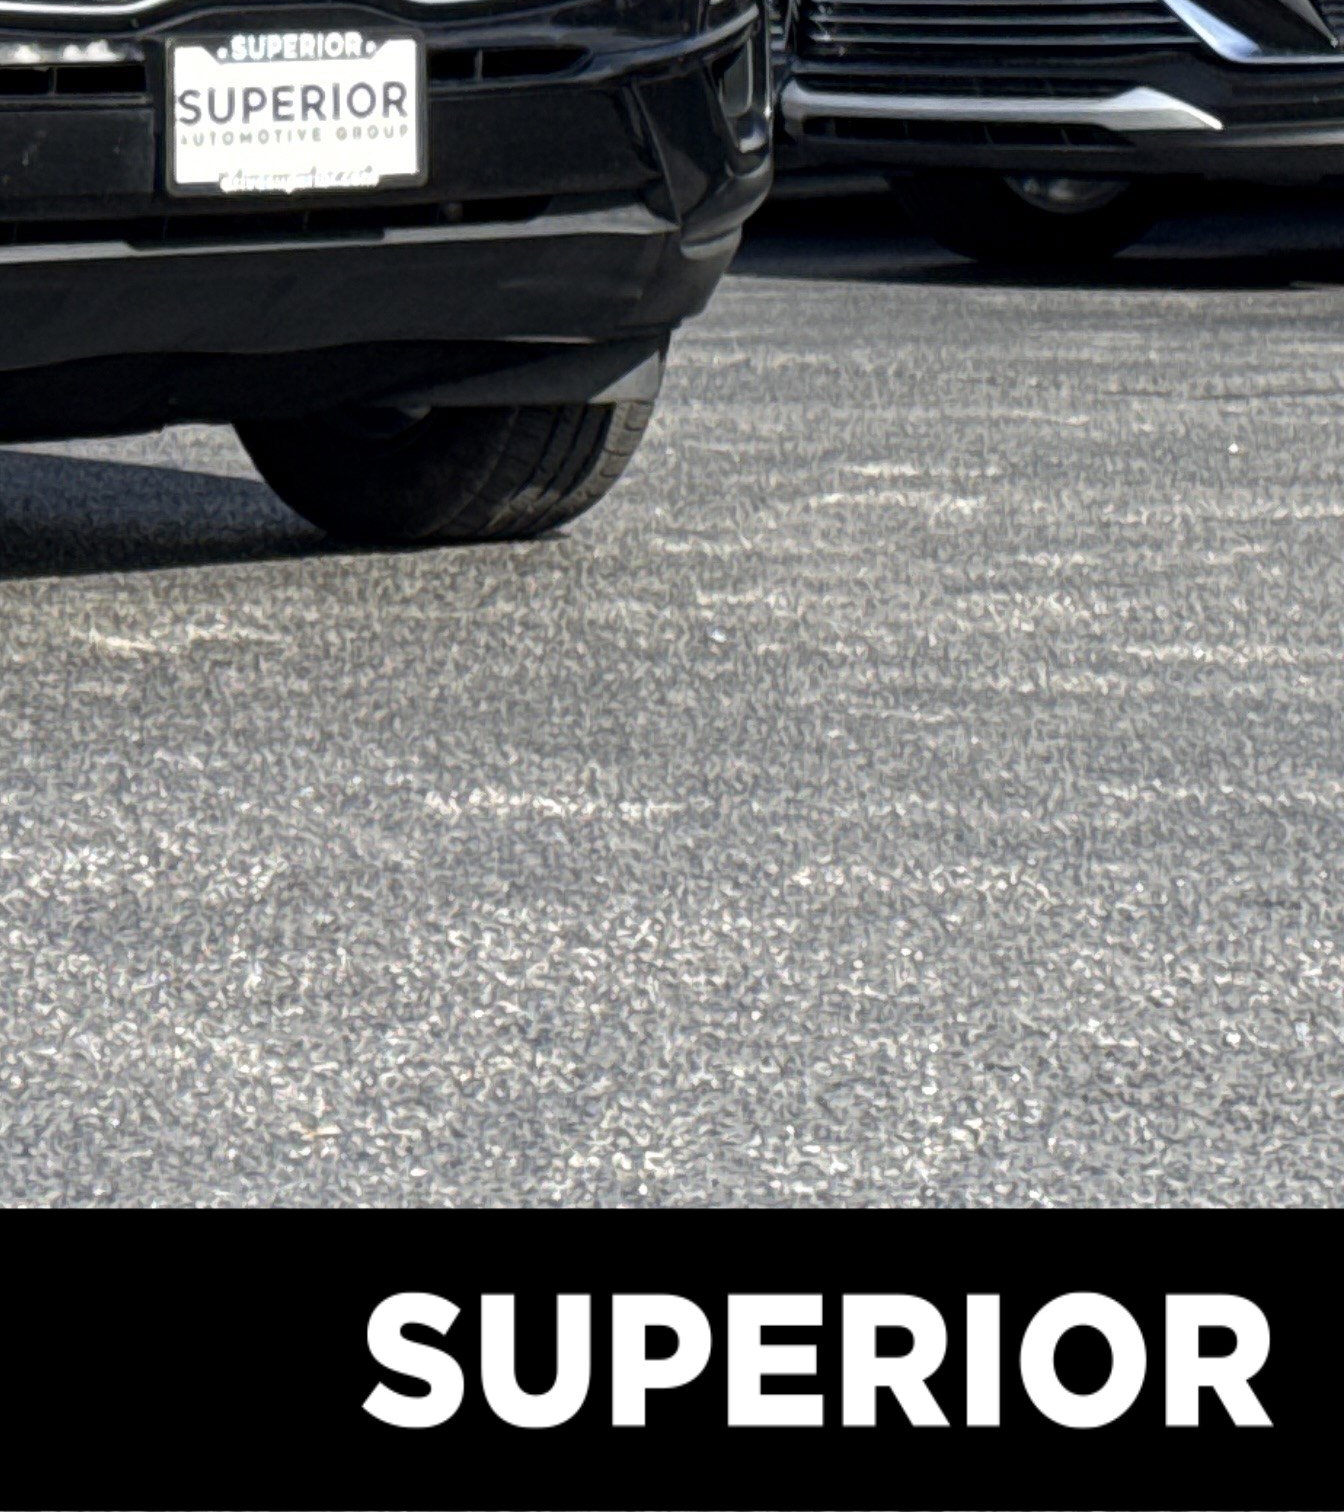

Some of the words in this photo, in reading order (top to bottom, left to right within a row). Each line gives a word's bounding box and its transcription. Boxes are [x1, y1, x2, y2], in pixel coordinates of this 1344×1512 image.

[230, 31, 363, 61] SUPERIOR
[177, 80, 408, 125] SUPERIOR
[180, 127, 322, 147] AUTOMOTIVE
[335, 124, 409, 142] GROUP
